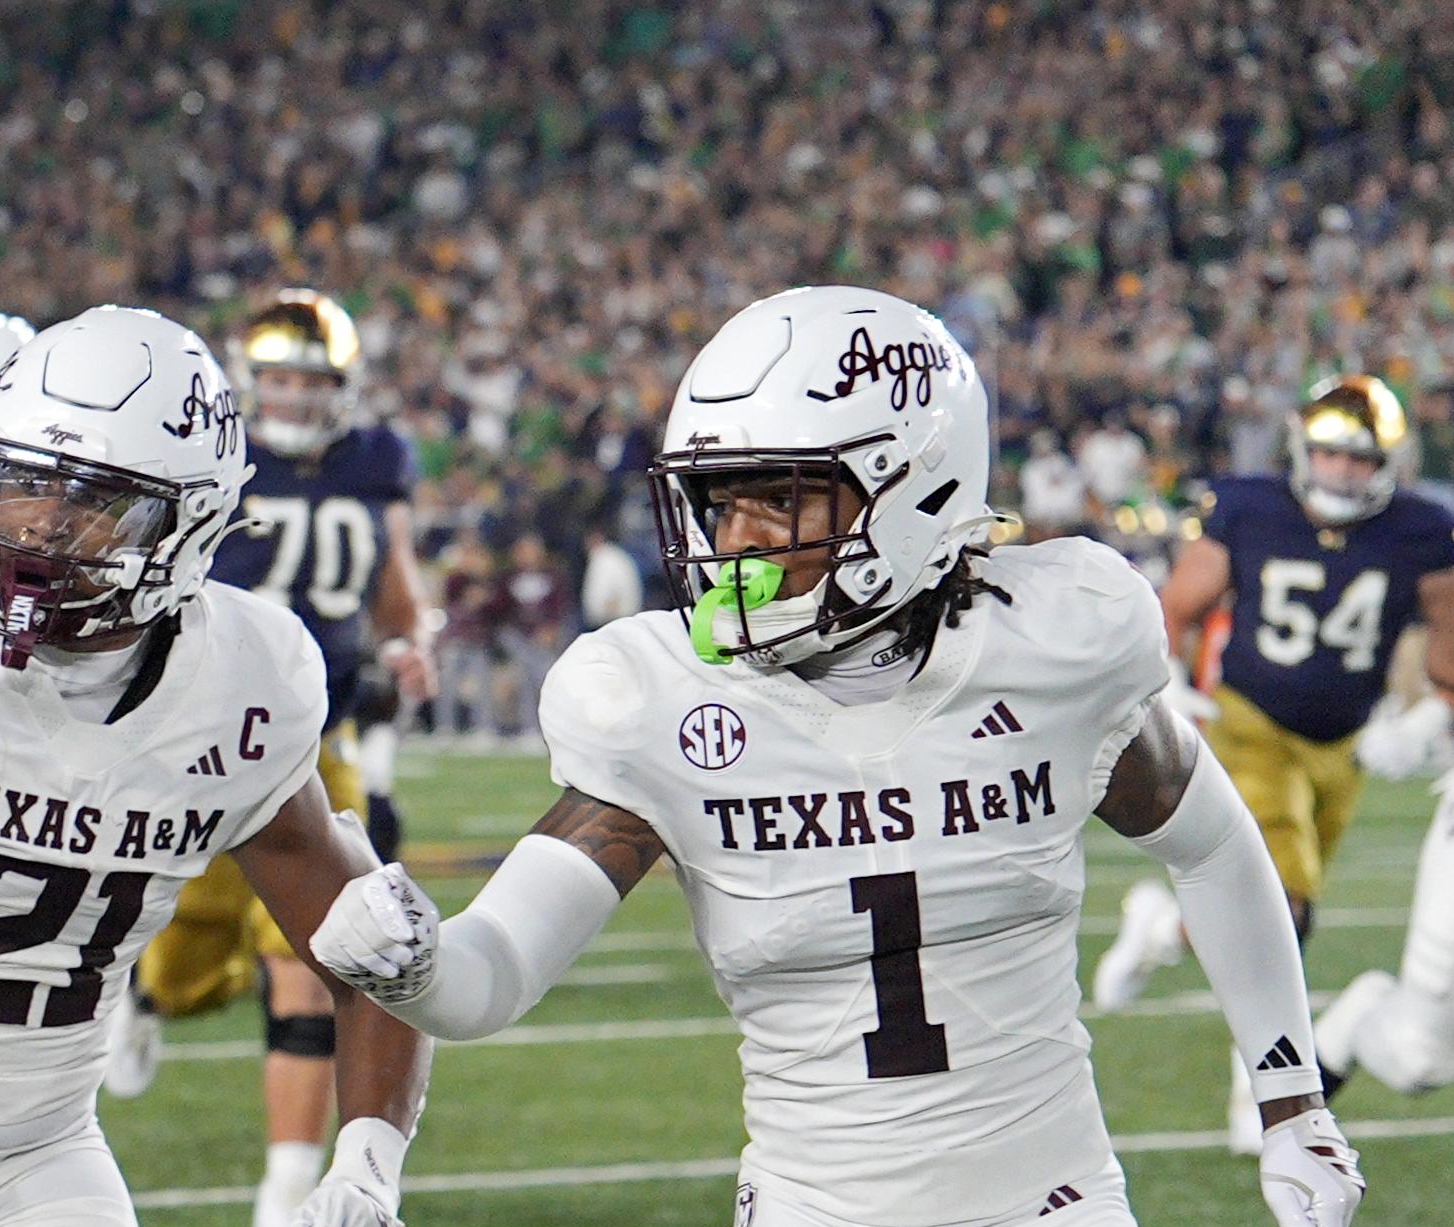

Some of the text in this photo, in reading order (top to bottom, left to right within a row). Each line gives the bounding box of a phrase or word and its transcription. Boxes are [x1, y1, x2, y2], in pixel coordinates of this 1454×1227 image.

[806, 327, 967, 412] Aggie
[243, 494, 377, 619] 70
[1255, 557, 1391, 674] 54
[239, 707, 269, 761] C
[679, 703, 746, 771] SEC
[114, 809, 225, 859] A&M
[704, 761, 1056, 852] TEXAS A&M
[851, 871, 949, 1079] 1
